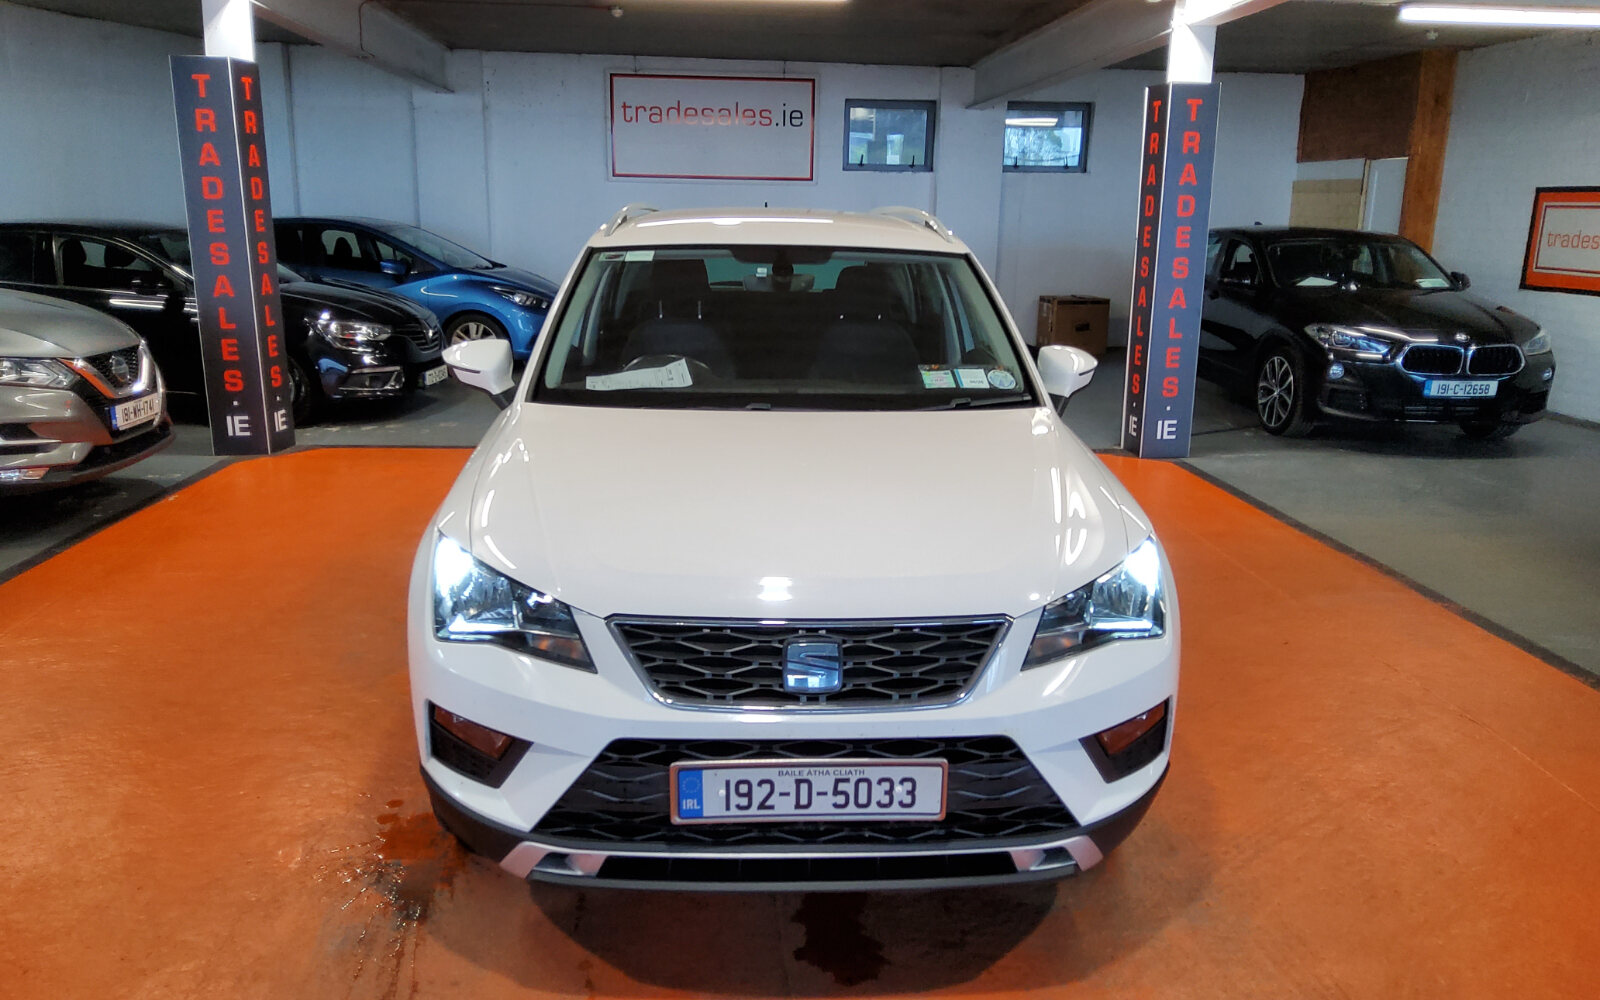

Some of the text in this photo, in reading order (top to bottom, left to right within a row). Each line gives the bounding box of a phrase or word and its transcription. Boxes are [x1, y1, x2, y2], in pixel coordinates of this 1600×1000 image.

[621, 100, 804, 128] tradesales.ie
[1436, 383, 1491, 395] 191-C-12658
[777, 769, 804, 777] BAILE
[724, 777, 917, 812] 192-D-5033
[682, 798, 701, 810] IRL
